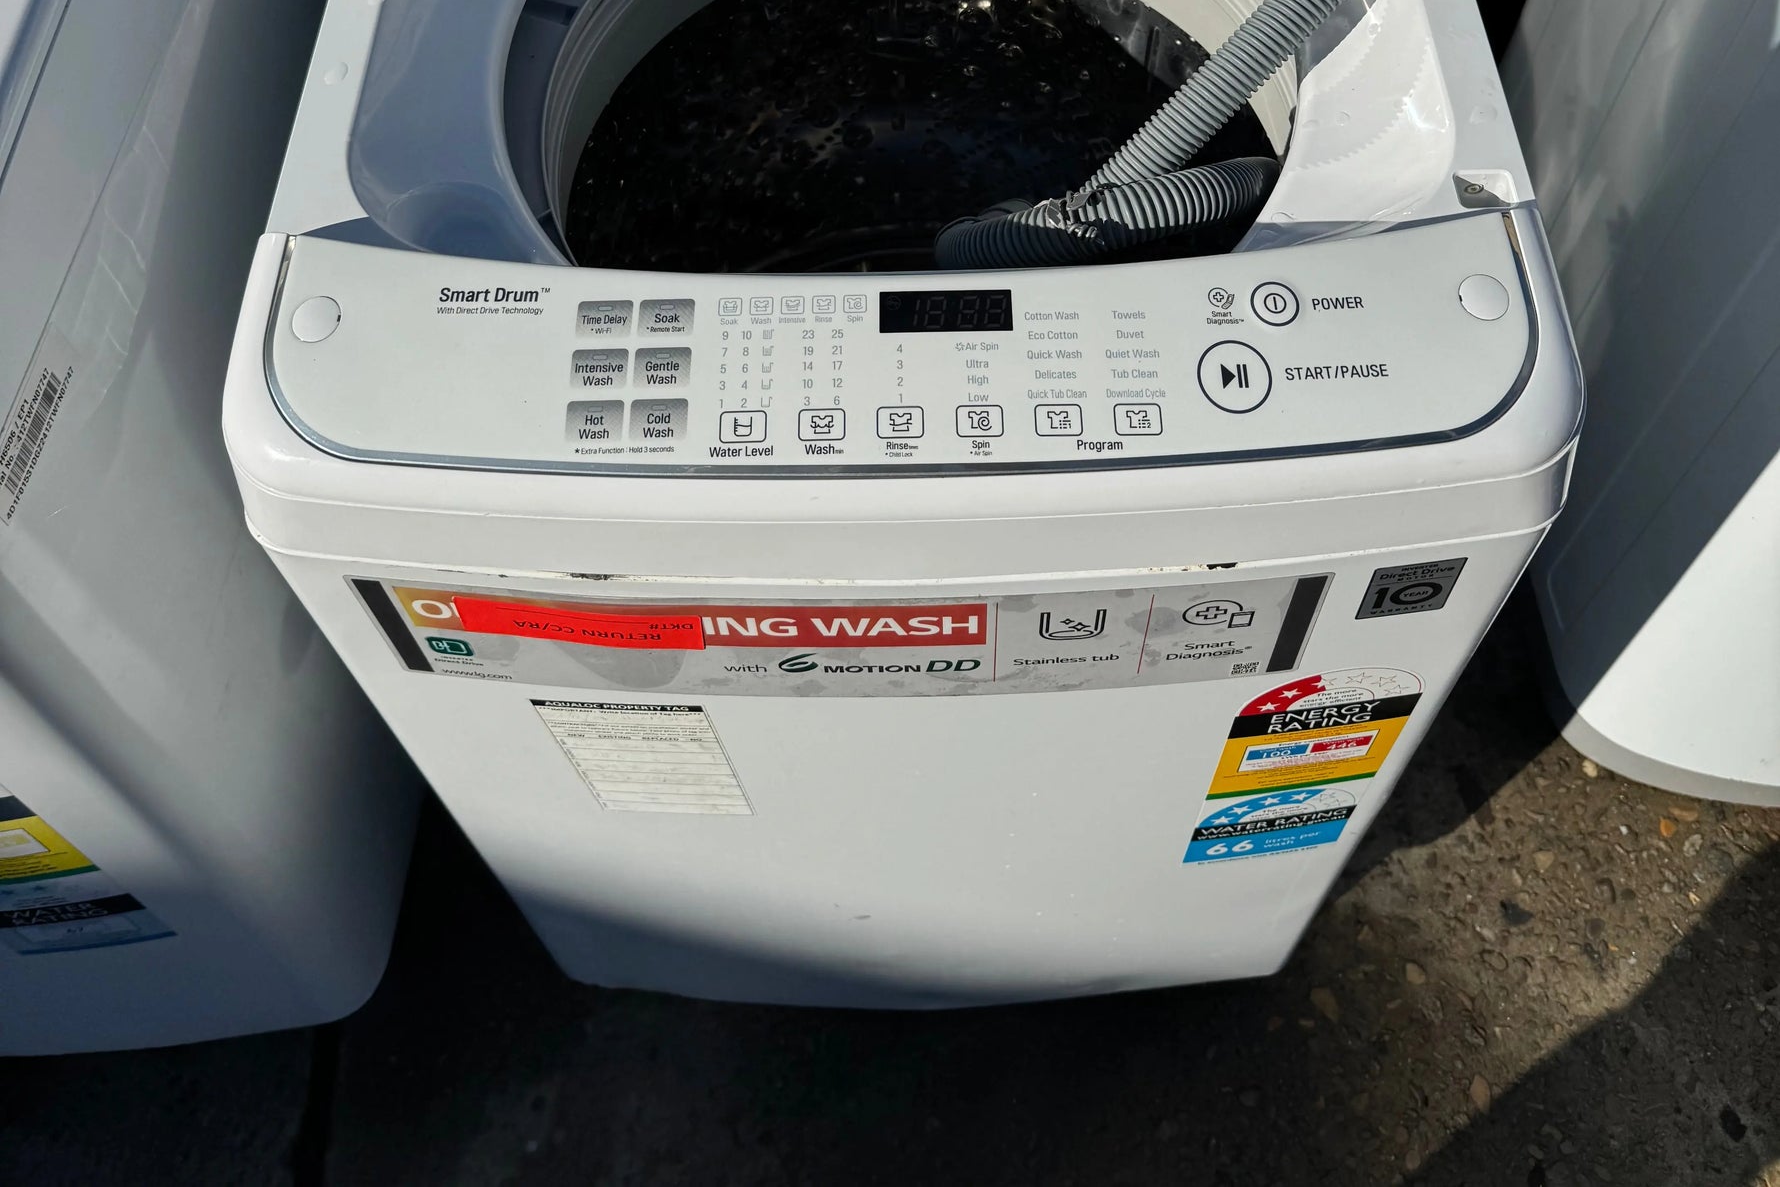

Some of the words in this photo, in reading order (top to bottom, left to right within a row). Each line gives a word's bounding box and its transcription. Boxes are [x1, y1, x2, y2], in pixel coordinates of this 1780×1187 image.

[439, 287, 490, 303] Smart
[1312, 296, 1364, 311] POWER
[437, 306, 455, 315] With
[456, 306, 479, 315] Direct
[480, 307, 499, 315] Drive
[500, 306, 544, 316] Technology
[1024, 312, 1053, 321] Cotton
[1055, 311, 1080, 320] Wash
[1111, 310, 1146, 320] Towels
[582, 315, 602, 325] Time
[604, 314, 628, 326] Delay
[654, 313, 680, 324] Soak
[720, 318, 739, 326] Soak
[750, 317, 772, 325] Wash
[778, 316, 806, 324] Intensive
[815, 315, 833, 324] Rinse
[846, 315, 864, 323] Spin
[722, 330, 729, 341] 9
[742, 330, 752, 340] 10
[802, 329, 815, 340] 23
[831, 329, 844, 339] 25
[1028, 331, 1045, 340] Eco
[1047, 330, 1079, 340] Cotton
[1116, 330, 1144, 339] Duvet
[722, 347, 728, 357] 7
[742, 347, 749, 357] 8
[803, 346, 814, 356] 19
[831, 345, 843, 355] 21
[896, 344, 903, 353] 4
[965, 342, 979, 351] Air
[980, 342, 999, 351] Spin
[1027, 350, 1053, 360] Quick
[1055, 350, 1082, 359] Wash
[1105, 349, 1130, 359] Quiet
[1132, 349, 1160, 359] Wash
[574, 362, 624, 374] Intensive
[645, 361, 680, 372] Gentle
[720, 364, 727, 374] 5
[742, 363, 749, 373] 6
[803, 361, 813, 371] 14
[832, 361, 843, 371] 17
[897, 360, 904, 370] 3
[966, 359, 989, 369] Ultra
[1035, 370, 1077, 379] Delicates
[1111, 369, 1129, 379] Tub
[1131, 369, 1158, 379] Clean
[1284, 363, 1390, 381] START/PAUSE
[582, 375, 613, 386] Wash
[646, 374, 677, 385] Wash
[802, 379, 813, 389] 10
[832, 378, 843, 388] 12
[897, 376, 904, 387] 2
[967, 375, 989, 386] High
[719, 380, 726, 391] 3
[741, 380, 748, 390] 4
[899, 393, 903, 403] 1
[968, 392, 990, 403] Low
[1027, 390, 1049, 399] Quick
[1050, 389, 1065, 399] Tub
[1066, 389, 1088, 399] Clean
[1106, 389, 1144, 399] Download
[1145, 388, 1166, 400] Cycle
[719, 399, 724, 408] 1
[740, 398, 748, 408] 2
[803, 396, 811, 406] 3
[833, 395, 840, 406] 6
[585, 414, 604, 426] Hot
[647, 413, 671, 424] Cold
[578, 428, 610, 440] Wash
[643, 427, 674, 439] Wash
[581, 447, 598, 455] Extra
[629, 446, 643, 454] Hold
[649, 446, 674, 454] seconds
[804, 444, 835, 455] Wash
[886, 441, 909, 450] Rinse
[971, 440, 990, 450] Spin
[1076, 439, 1124, 453] Program
[709, 446, 743, 458] Water
[745, 445, 774, 457] Level
[1380, 570, 1419, 580] Direct
[1421, 566, 1456, 575] Drive
[1403, 590, 1429, 598] YEAR
[513, 619, 576, 634] CC/RA
[649, 622, 694, 631] DKT#
[810, 615, 979, 637] WASH
[581, 629, 662, 642] RETURN
[1184, 641, 1236, 651] Smart
[1013, 656, 1087, 666] Stainless
[1092, 654, 1120, 662] tub
[723, 663, 768, 674] with
[823, 664, 921, 674] MOTION
[925, 659, 981, 673] DD
[441, 668, 513, 681] www.lg.com
[545, 700, 600, 710] AQUALOC
[603, 703, 661, 712] PROPERTY
[1271, 701, 1381, 724] ENERGY
[1268, 713, 1372, 734] RATING
[1201, 820, 1268, 835] WATER
[1274, 808, 1348, 826] RATING
[1206, 839, 1255, 856] 66
[1300, 830, 1321, 840] per
